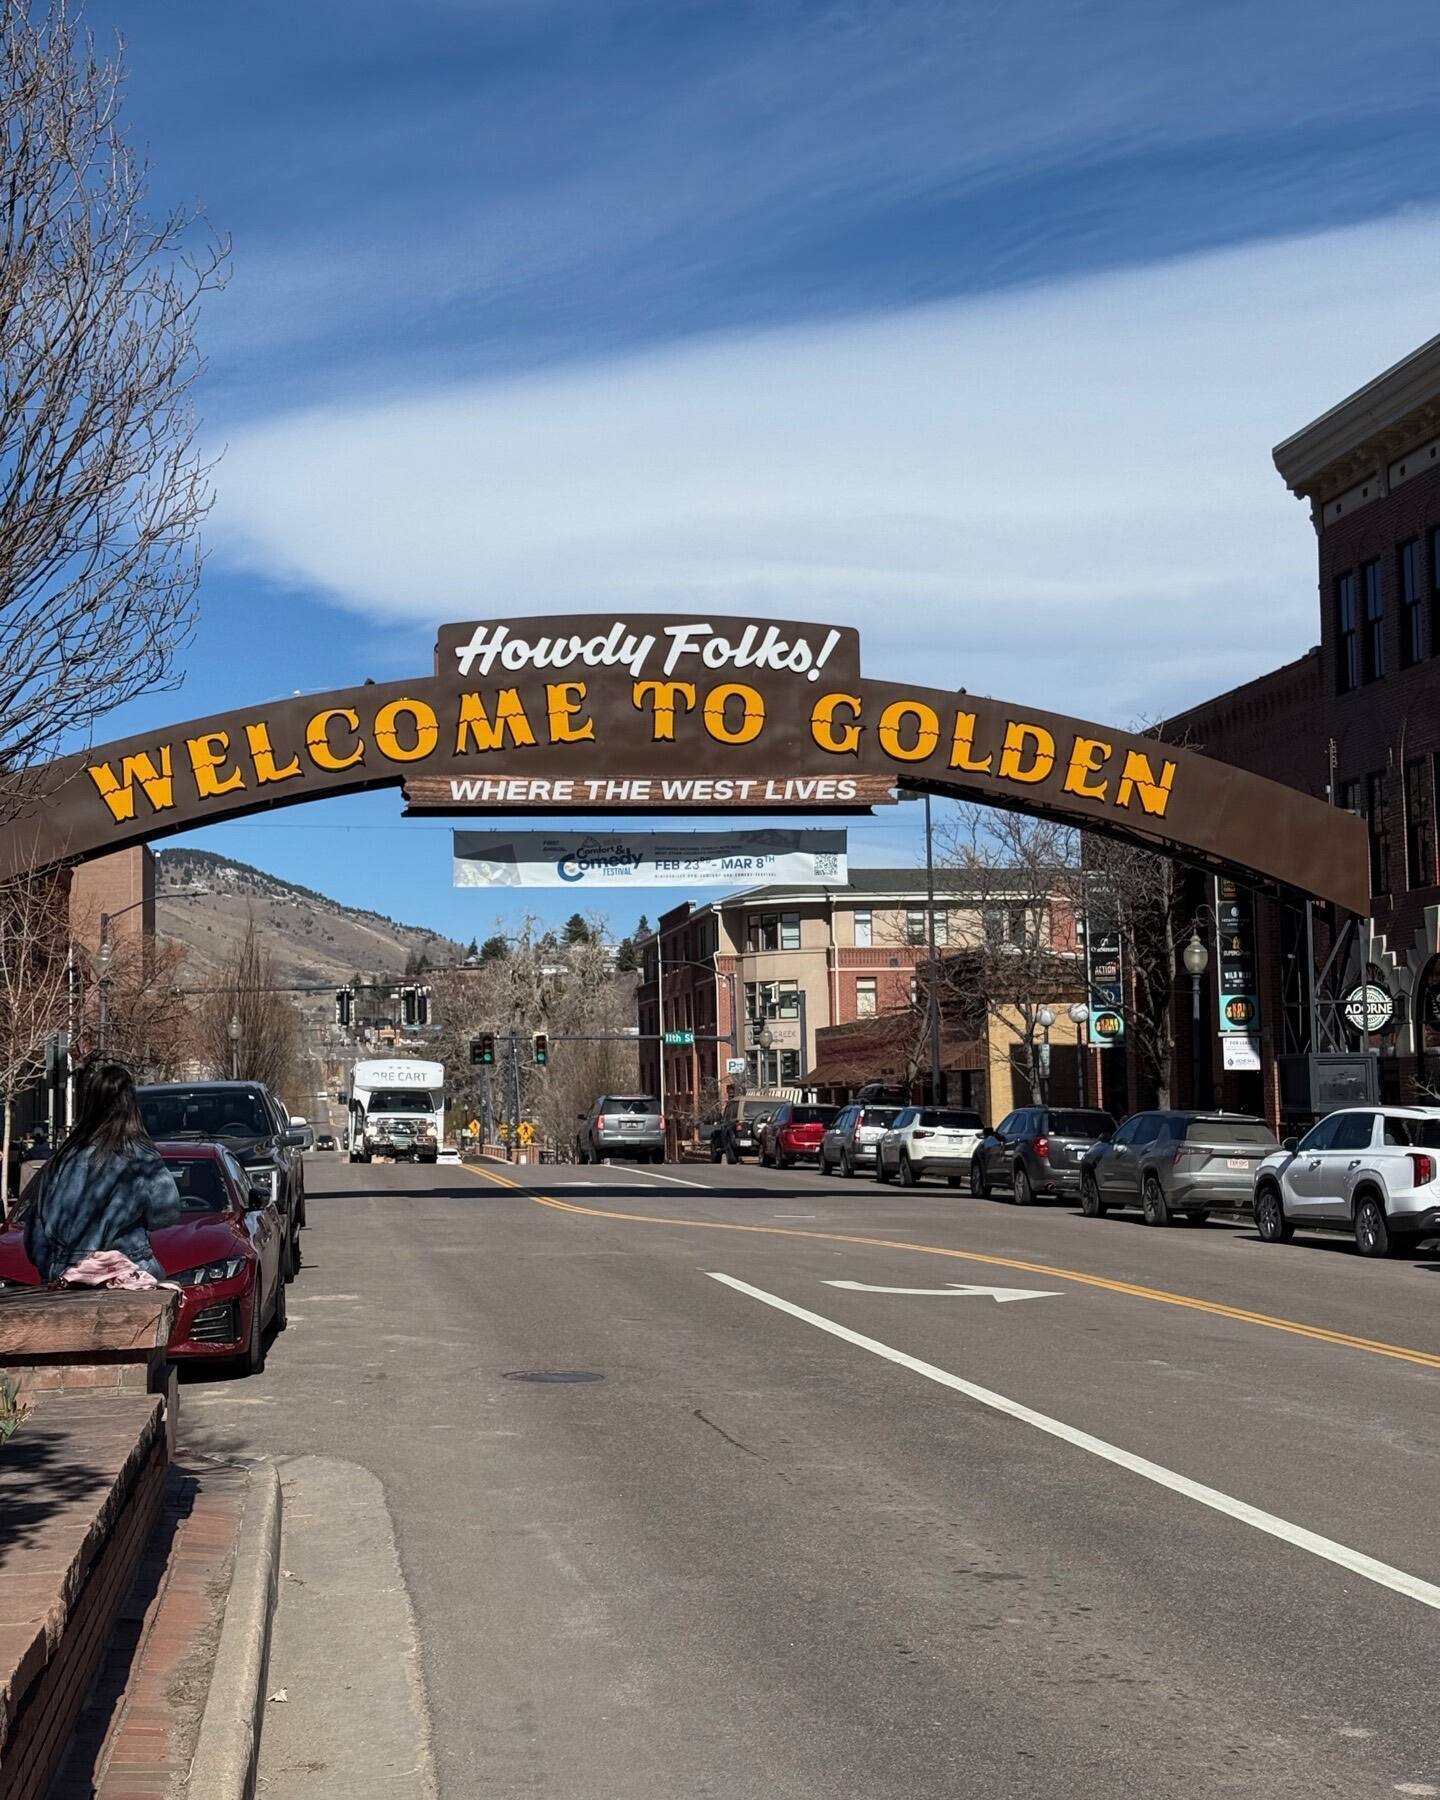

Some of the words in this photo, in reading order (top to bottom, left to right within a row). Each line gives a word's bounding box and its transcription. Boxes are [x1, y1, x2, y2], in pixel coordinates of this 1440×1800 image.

[455, 621, 656, 678] Howdy
[663, 623, 841, 682] Folks!
[86, 681, 595, 824] WELCOME
[632, 680, 766, 745] TO
[809, 692, 1178, 818] GOLDEN
[450, 780, 574, 800] WHERE
[583, 780, 652, 800] THE
[661, 780, 758, 800] WEST
[763, 780, 857, 800] LIVES
[576, 846, 615, 859] Comfort
[557, 847, 643, 882] Comedy
[655, 860, 680, 870] FEB
[721, 858, 752, 870] MAR
[603, 867, 632, 876] FESTIVAL
[1344, 1003, 1393, 1014] ADORNE
[665, 1033, 681, 1043] 11th
[685, 1034, 694, 1043] St
[397, 1071, 428, 1082] CART
